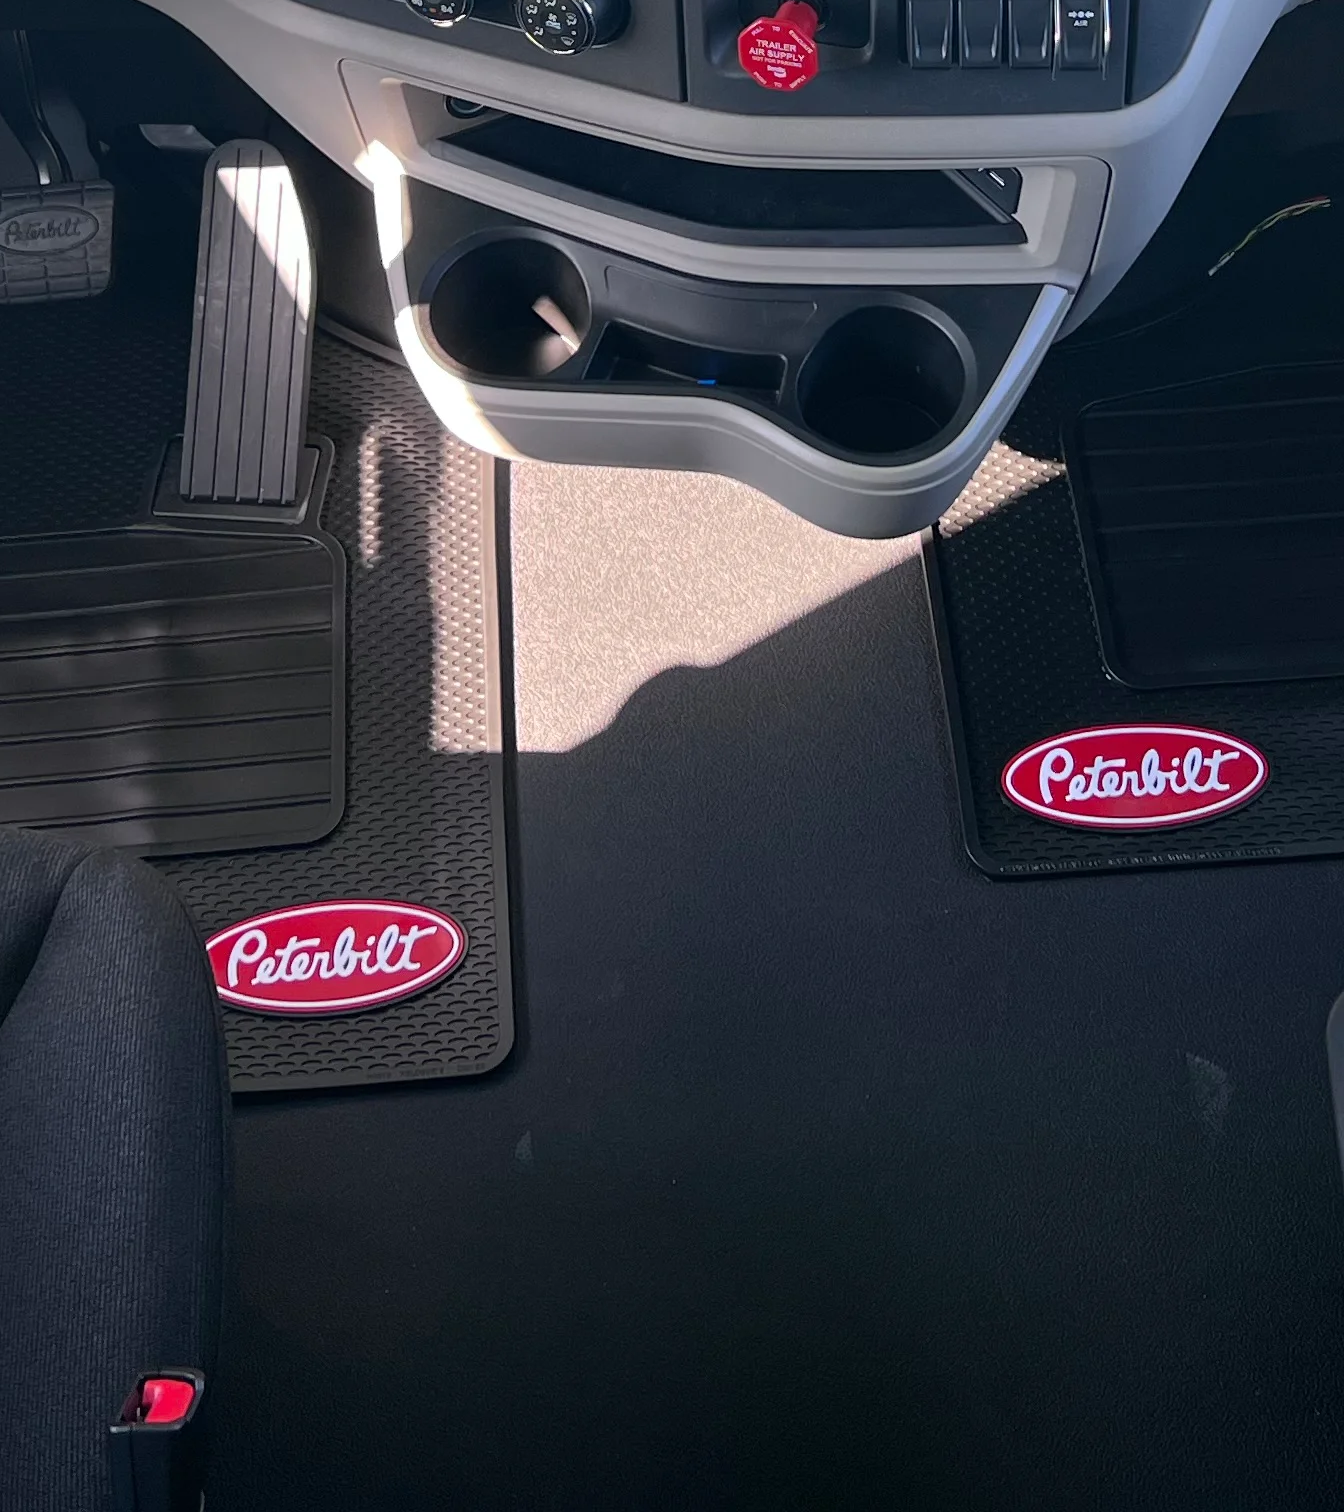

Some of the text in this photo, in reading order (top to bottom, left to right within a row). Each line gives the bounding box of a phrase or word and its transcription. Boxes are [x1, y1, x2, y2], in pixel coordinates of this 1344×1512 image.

[440, 4, 454, 14] 84
[1073, 19, 1088, 27] AIR
[756, 38, 797, 52] TRAILER
[749, 47, 805, 62] AIR SUPPLY
[1039, 747, 1240, 805] Peterbilt
[226, 924, 438, 988] Peterbilt
